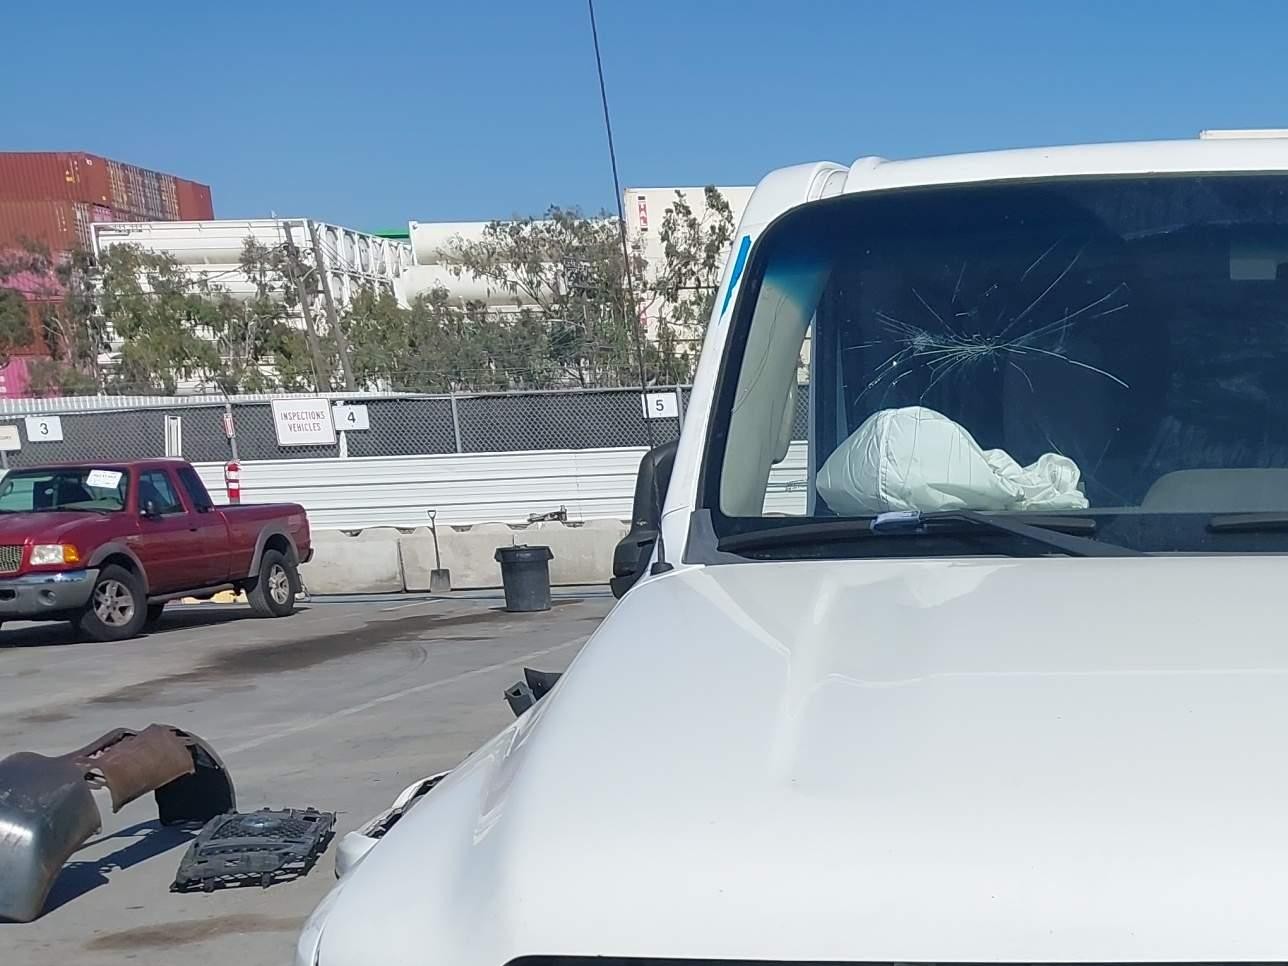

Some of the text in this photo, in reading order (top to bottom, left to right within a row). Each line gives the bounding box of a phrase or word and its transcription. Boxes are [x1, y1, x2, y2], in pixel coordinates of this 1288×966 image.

[655, 399, 665, 412] 5
[280, 410, 326, 421] INSPECTIONS
[347, 411, 356, 424] 4
[39, 422, 49, 435] 3
[288, 422, 322, 433] VEHICLES
